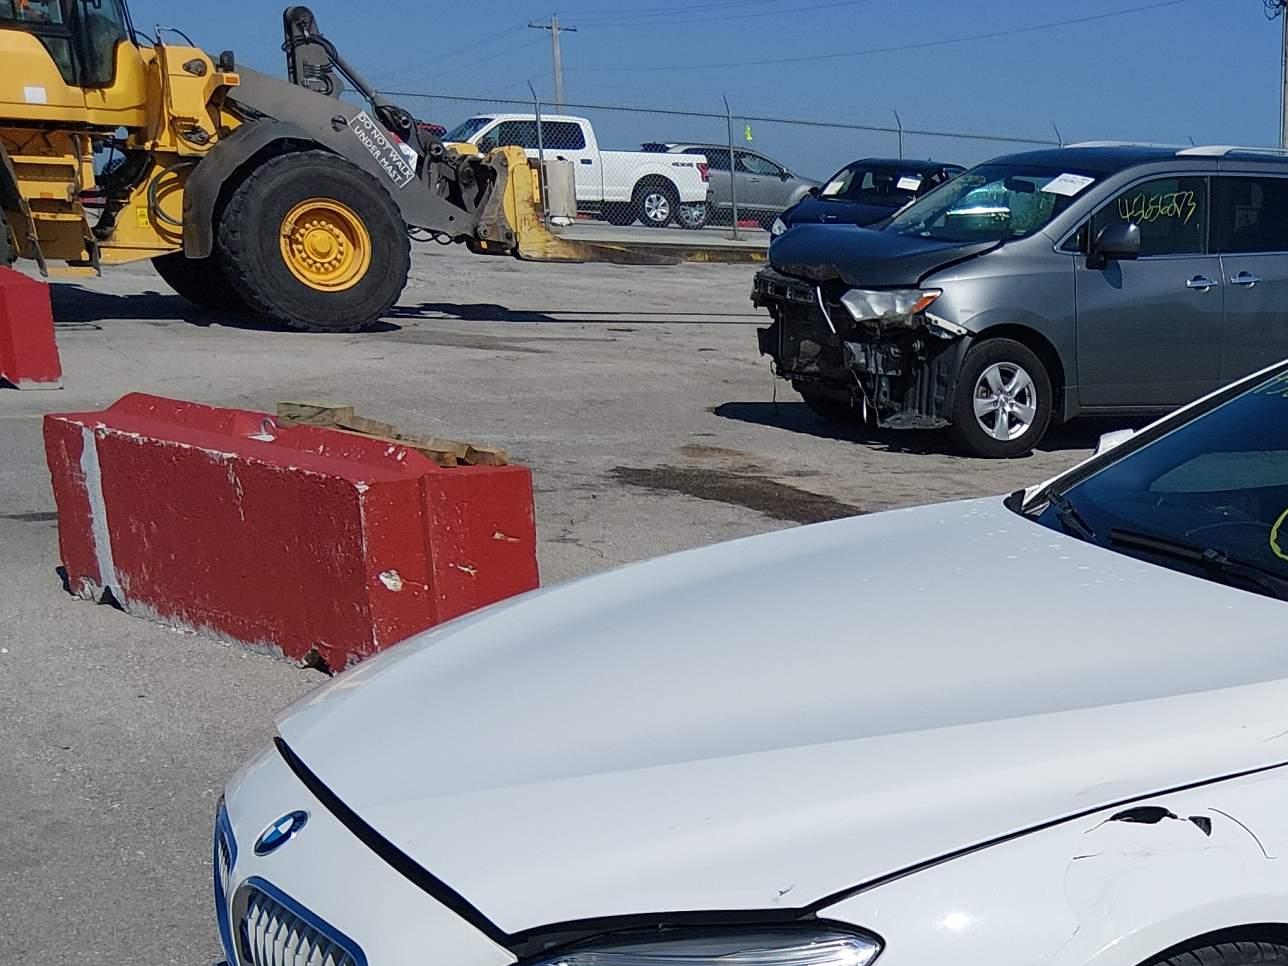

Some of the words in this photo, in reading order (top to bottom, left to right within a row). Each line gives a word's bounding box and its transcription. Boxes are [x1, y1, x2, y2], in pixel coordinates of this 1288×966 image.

[354, 125, 382, 160] UNDER
[380, 157, 403, 182] MAST
[357, 114, 372, 129] DO
[370, 129, 393, 151] NOT
[389, 150, 412, 180] WALK
